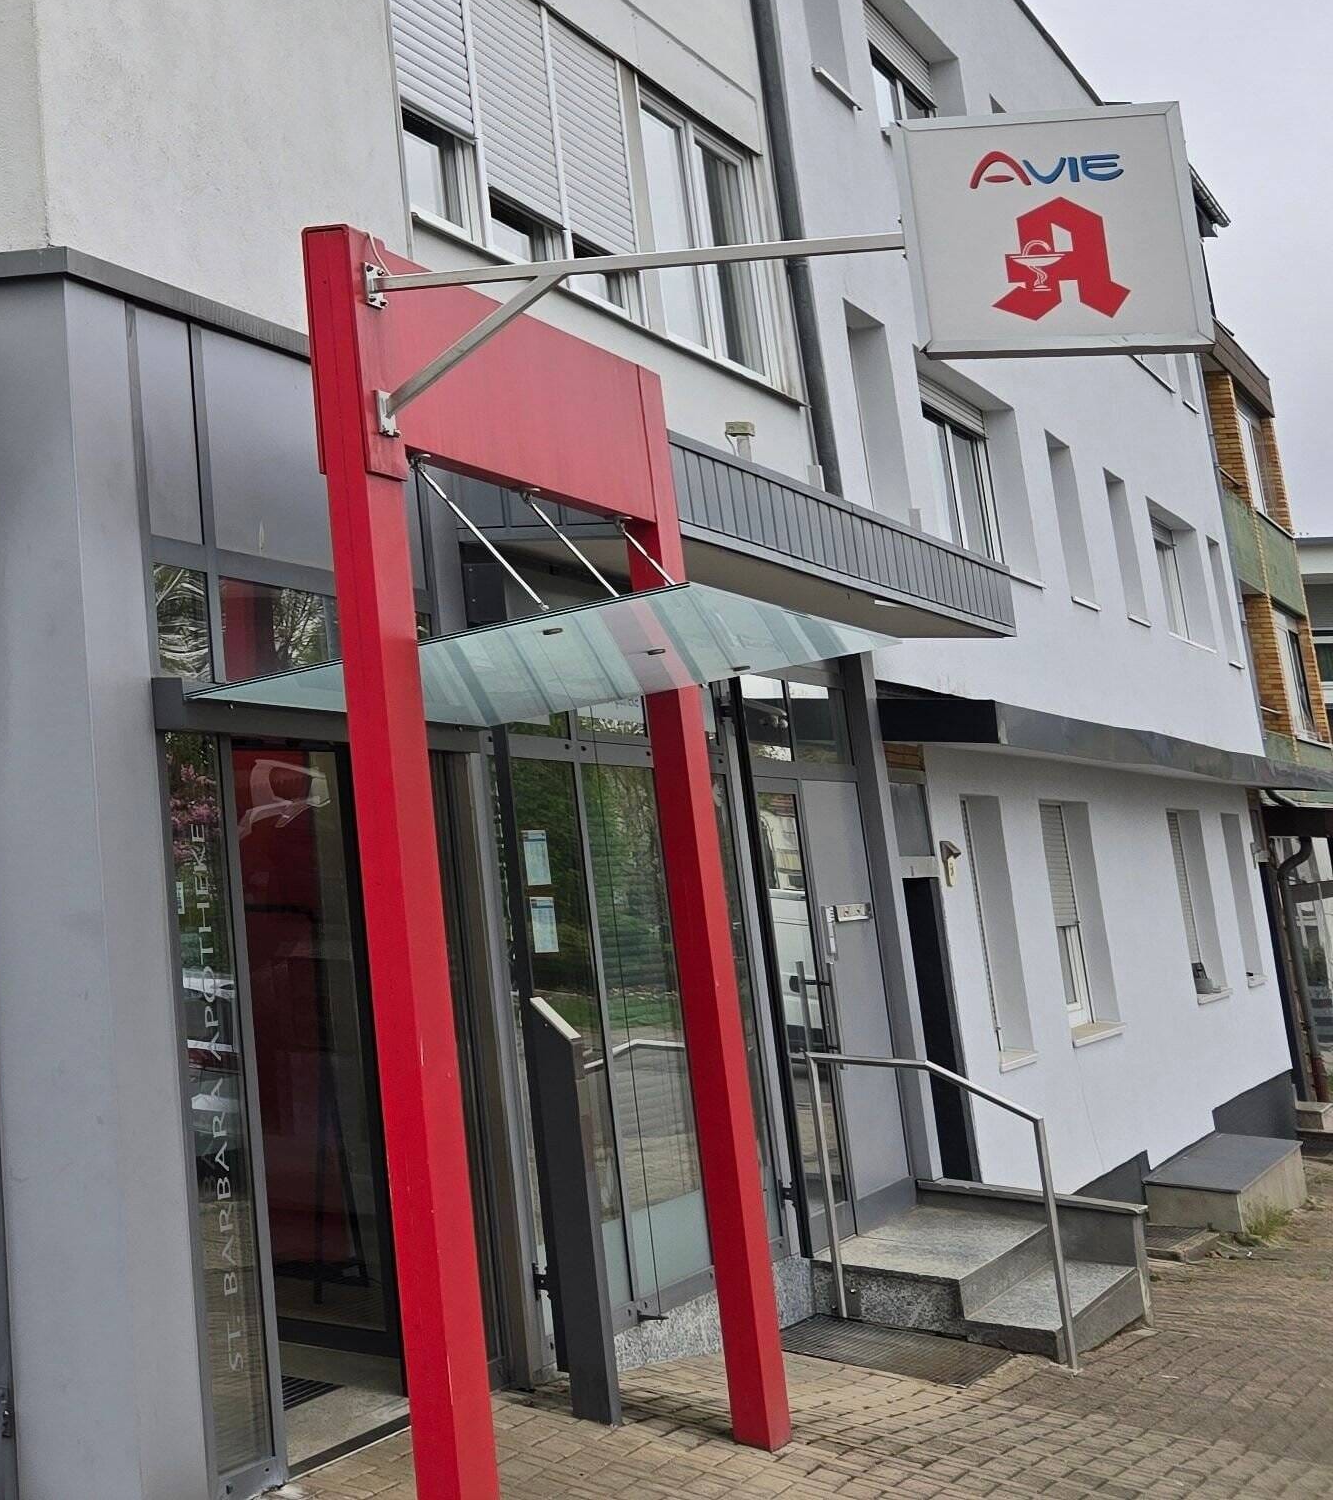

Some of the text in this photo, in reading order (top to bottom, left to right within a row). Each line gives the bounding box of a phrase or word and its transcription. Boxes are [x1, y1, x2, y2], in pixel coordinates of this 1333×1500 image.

[969, 150, 1124, 190] AVIE
[188, 822, 246, 1373] ST. BARBARA APOTHEKE
